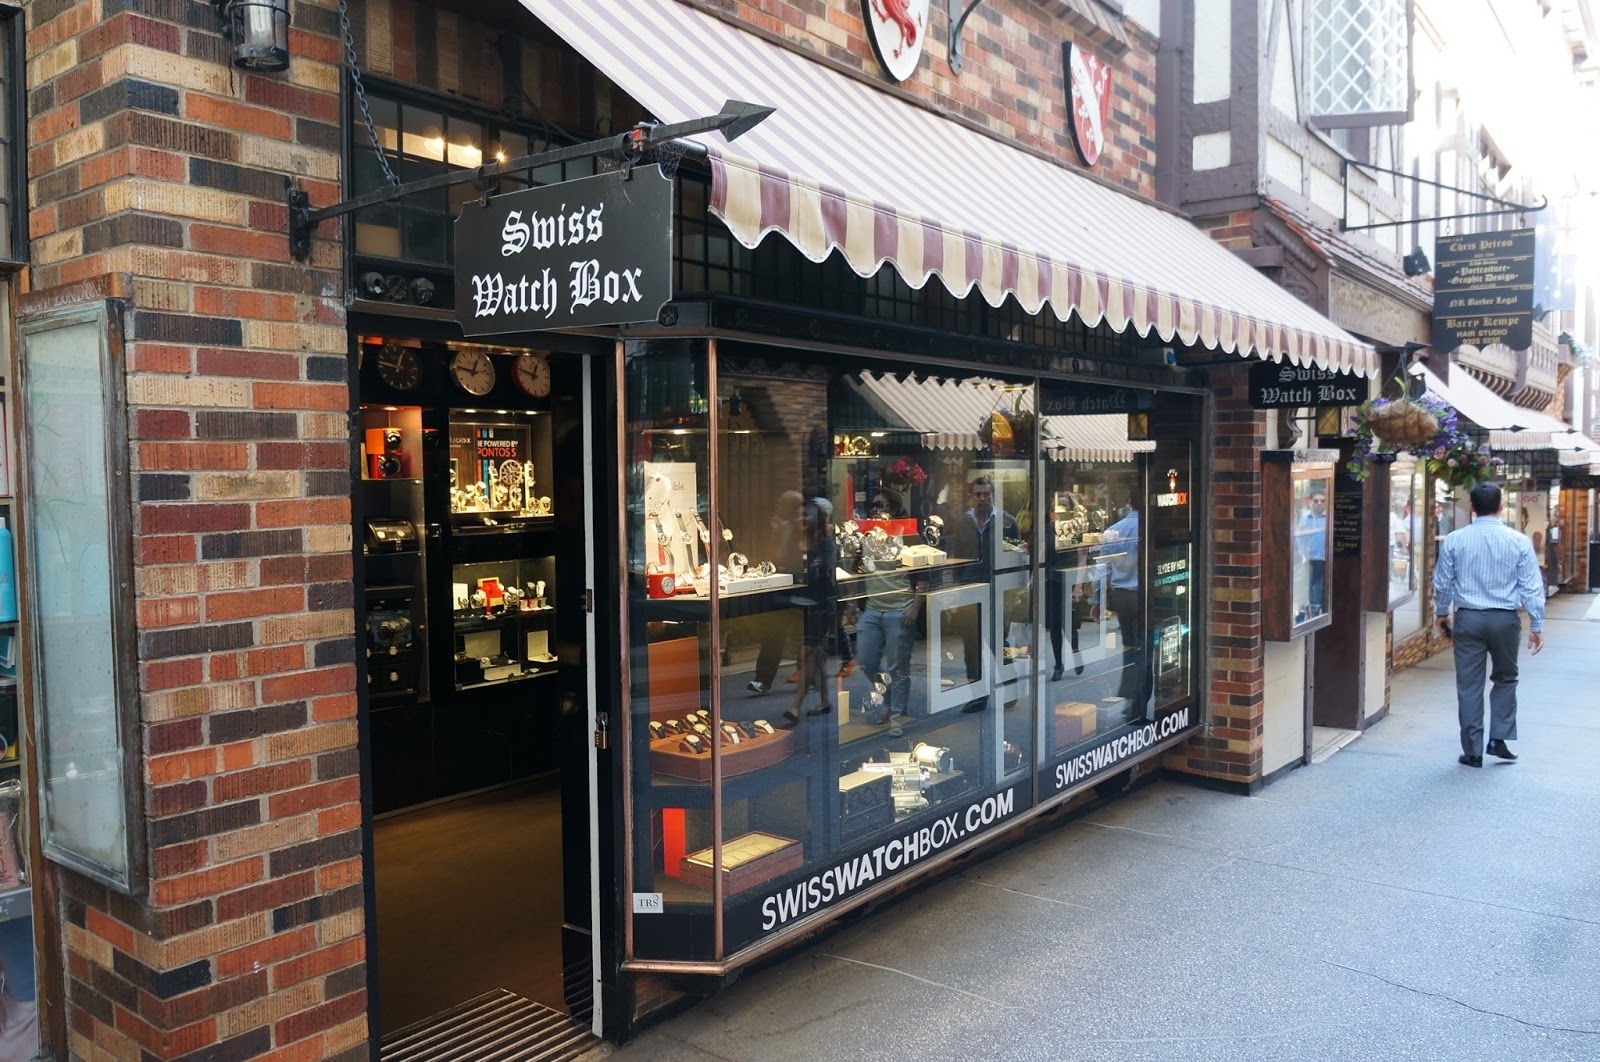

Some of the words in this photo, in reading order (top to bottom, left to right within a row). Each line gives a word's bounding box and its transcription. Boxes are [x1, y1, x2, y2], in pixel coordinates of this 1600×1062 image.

[501, 202, 604, 257] Swiss
[1449, 241, 1476, 252] Chris
[471, 267, 558, 319] Watch
[568, 258, 643, 315] Box
[1446, 318, 1480, 329] Barry
[1456, 330, 1476, 338] HAIR
[1478, 329, 1508, 337] STUDIO
[1279, 366, 1337, 383] Swiss
[1260, 386, 1312, 405] Watch
[1317, 384, 1357, 403] Box
[1055, 707, 1189, 789] SWISSWATCHBOX.COM
[762, 788, 1014, 932] SWISSWATCHBOX.COM
[638, 899, 659, 907] TRS
